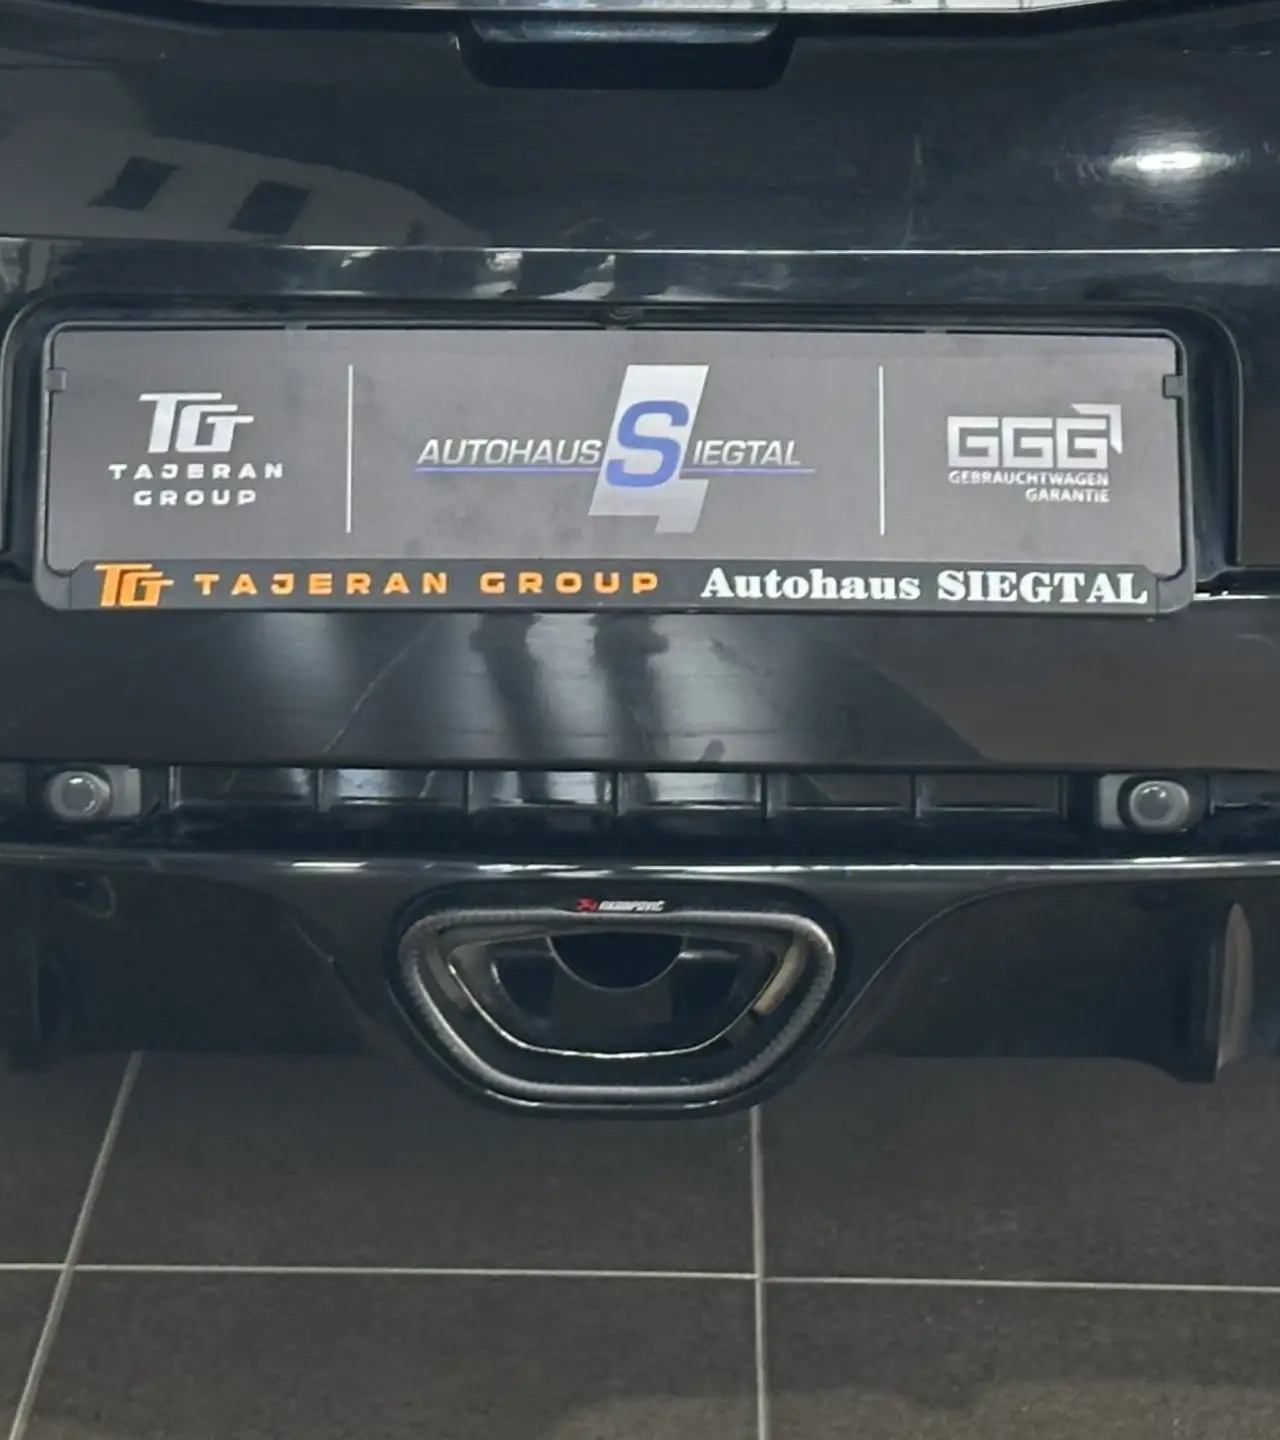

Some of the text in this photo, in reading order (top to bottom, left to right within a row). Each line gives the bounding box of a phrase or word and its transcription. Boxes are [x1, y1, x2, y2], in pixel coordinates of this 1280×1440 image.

[416, 438, 603, 467] AUTOHAUS
[947, 414, 1115, 469] GGG
[108, 462, 285, 480] TAJERAN
[948, 470, 1110, 487] GEBRAUCHTWAGEN
[133, 490, 258, 506] GROUP
[1024, 486, 1111, 503] GARANTIE
[193, 571, 450, 597] TAJERAN
[479, 571, 659, 596] GROUP
[700, 567, 1149, 605] Autohaus SIEGTAL
